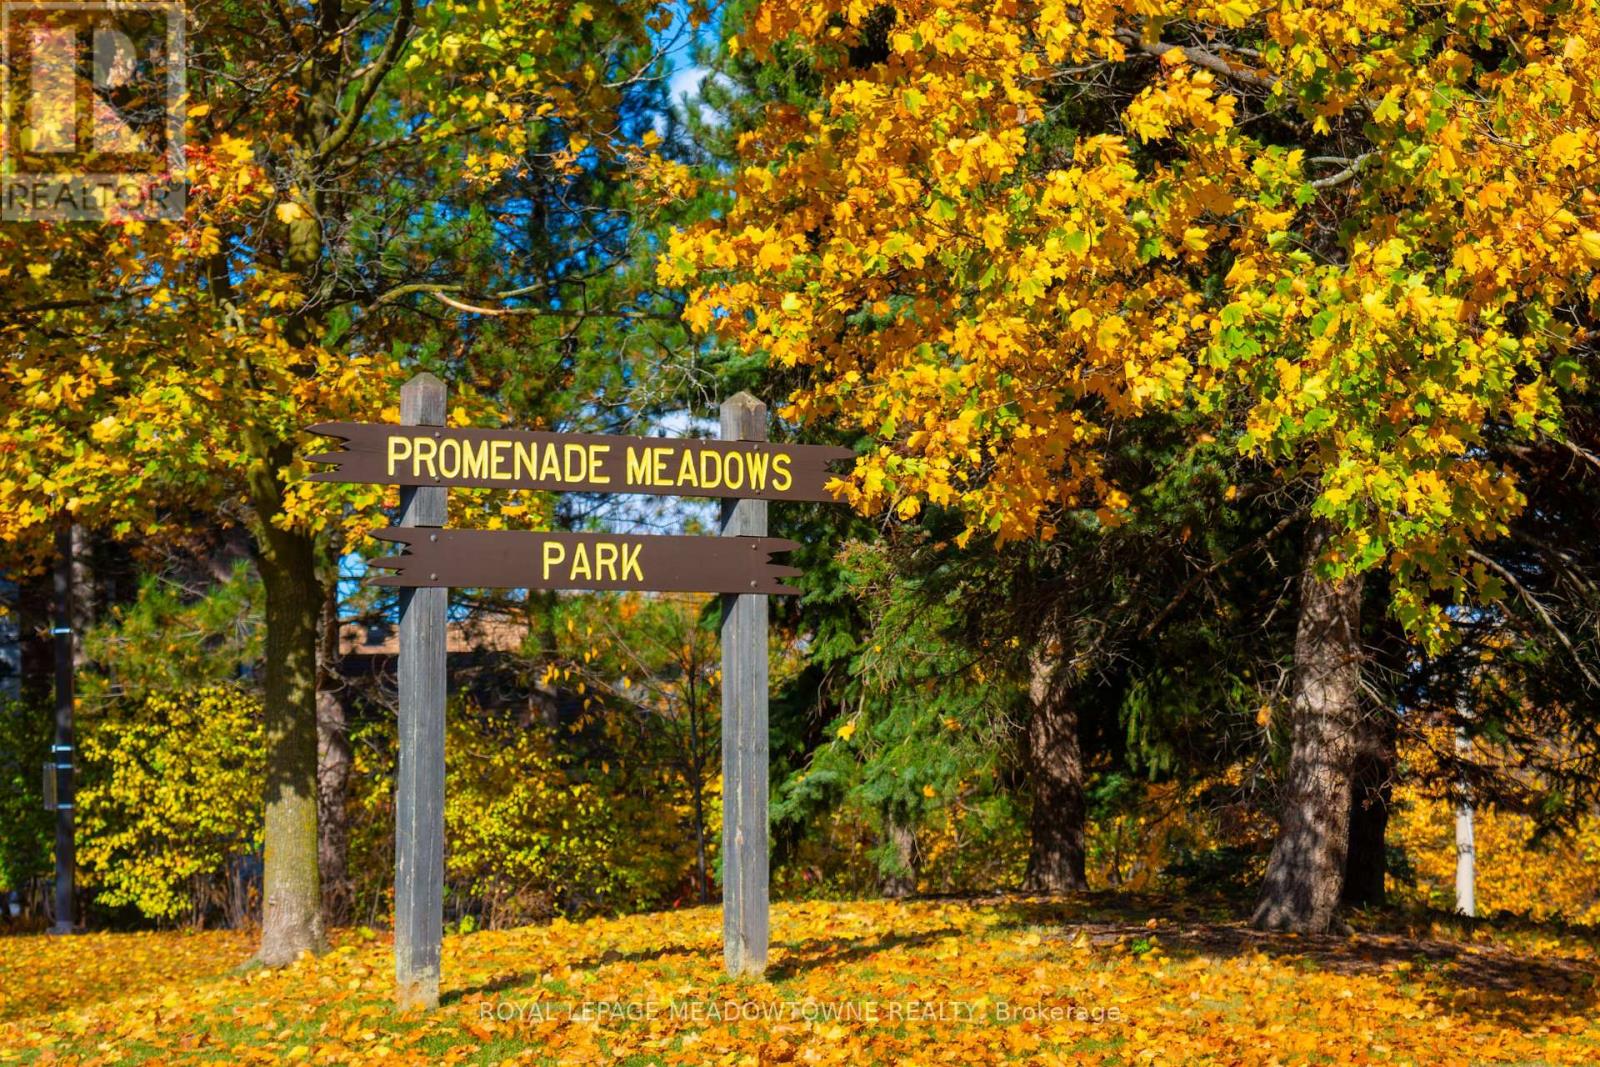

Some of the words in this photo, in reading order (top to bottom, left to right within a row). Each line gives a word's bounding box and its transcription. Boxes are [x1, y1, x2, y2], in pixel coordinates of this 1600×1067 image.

[387, 436, 611, 484] PROMENADE
[626, 447, 793, 491] MEADOWS
[542, 541, 645, 582] PARK
